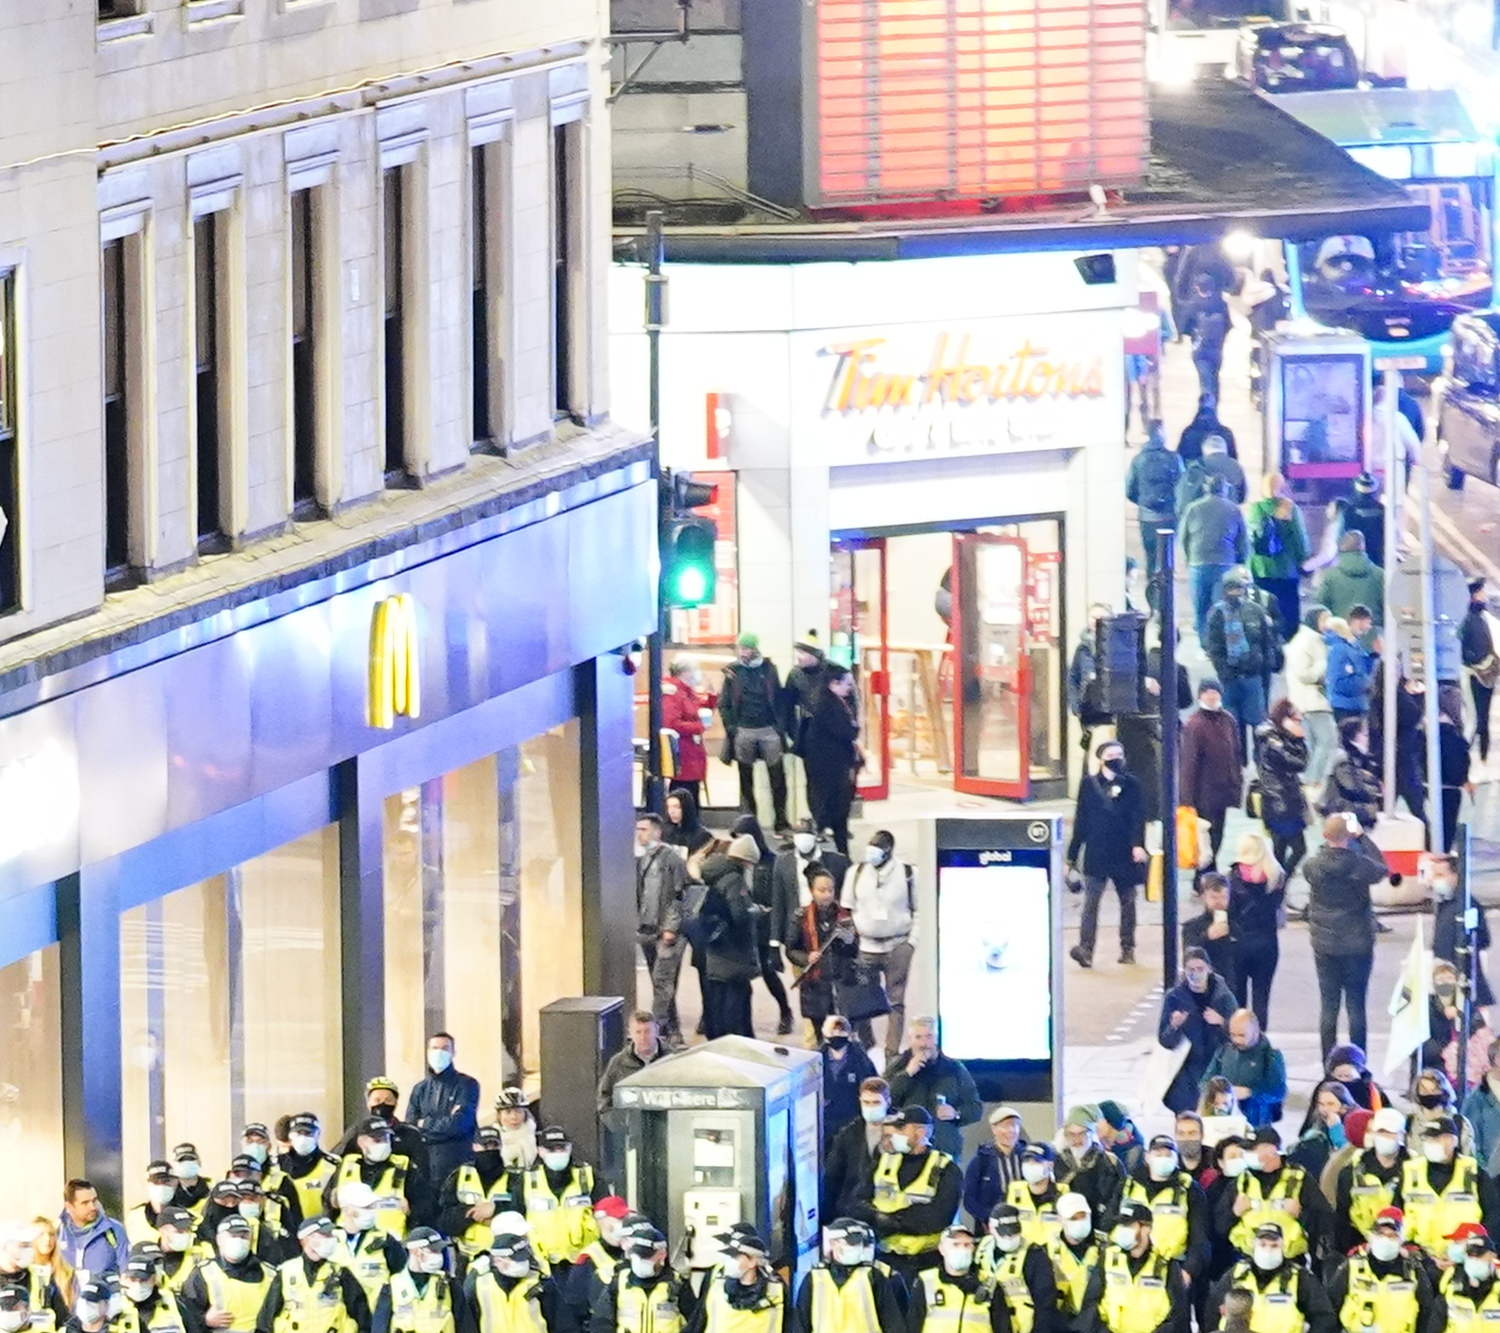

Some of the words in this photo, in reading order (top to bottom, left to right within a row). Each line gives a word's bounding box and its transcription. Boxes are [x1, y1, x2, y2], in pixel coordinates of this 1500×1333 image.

[817, 338, 914, 414] Tim
[914, 332, 1104, 408] Hortons
[979, 850, 1012, 865] global
